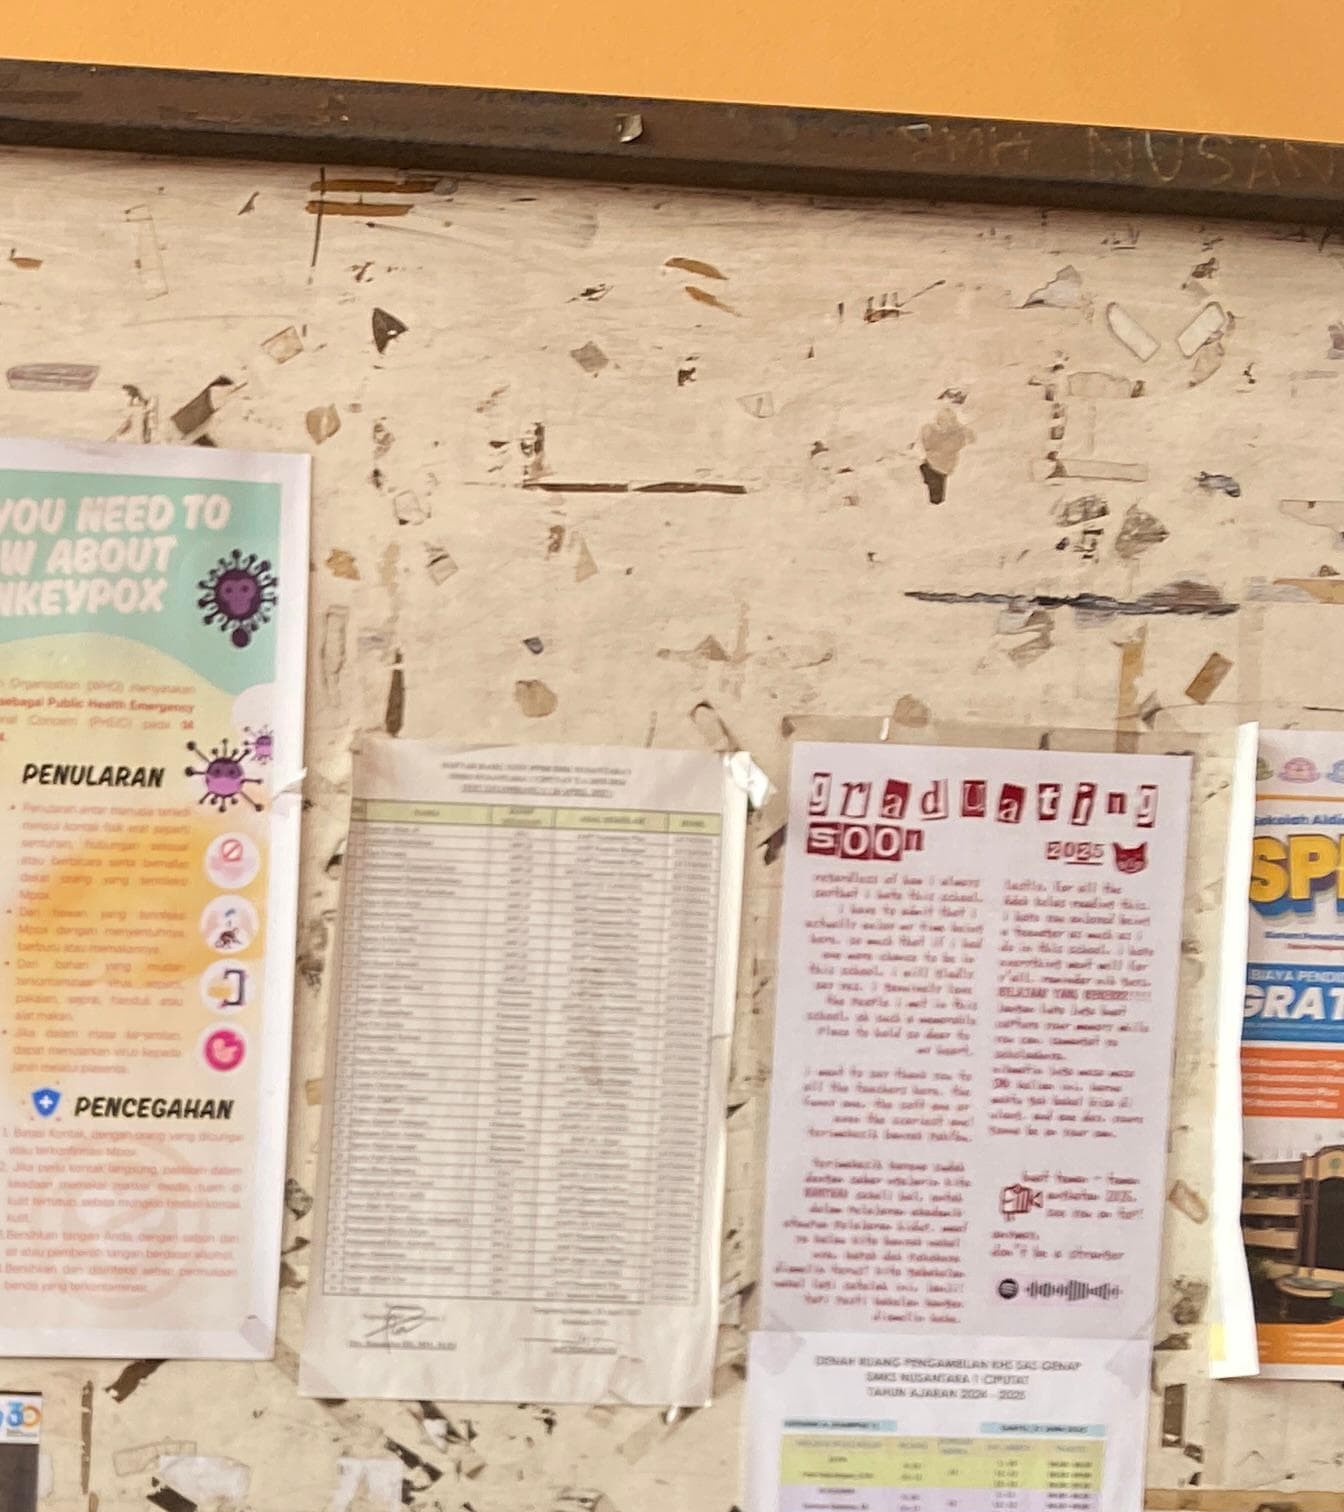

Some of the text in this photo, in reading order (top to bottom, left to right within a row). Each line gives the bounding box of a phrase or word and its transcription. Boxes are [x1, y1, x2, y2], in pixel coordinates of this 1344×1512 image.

[76, 494, 175, 533] NEED
[182, 493, 231, 530] TO
[46, 535, 178, 574] ABOUT
[22, 763, 165, 787] PENULARAN
[807, 822, 925, 862] soon
[75, 1097, 234, 1120] PENCEGAHAN
